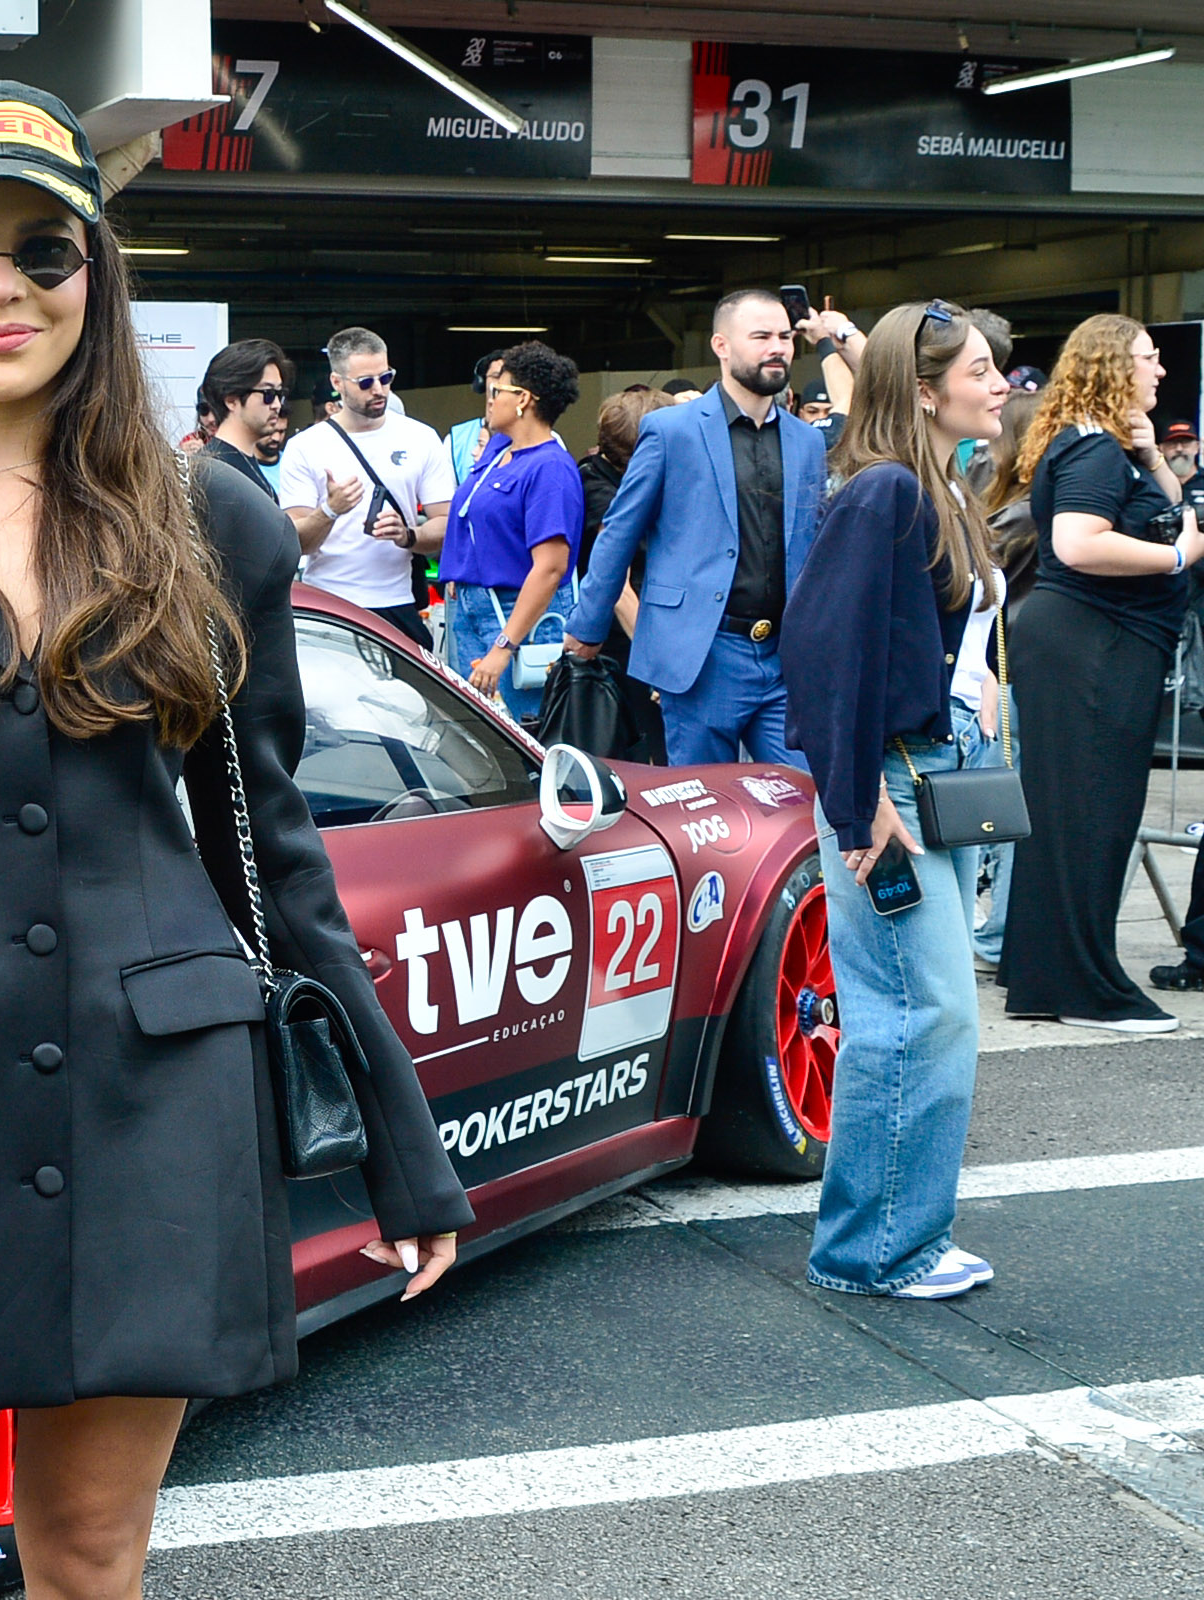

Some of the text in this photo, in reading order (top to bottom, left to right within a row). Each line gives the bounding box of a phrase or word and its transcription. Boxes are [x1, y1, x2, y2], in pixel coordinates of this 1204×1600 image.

[233, 59, 280, 130] 7
[426, 117, 502, 139] MIGUEL
[728, 79, 810, 149] 31
[917, 131, 1066, 160] SEBÁ MALUCELLI
[680, 814, 731, 854] JOOG
[877, 881, 912, 900] 10:49
[396, 894, 573, 1035] twe
[604, 892, 663, 993] 22
[438, 1052, 651, 1157] POKERSTARS
[767, 1064, 796, 1135] MICHELIN
